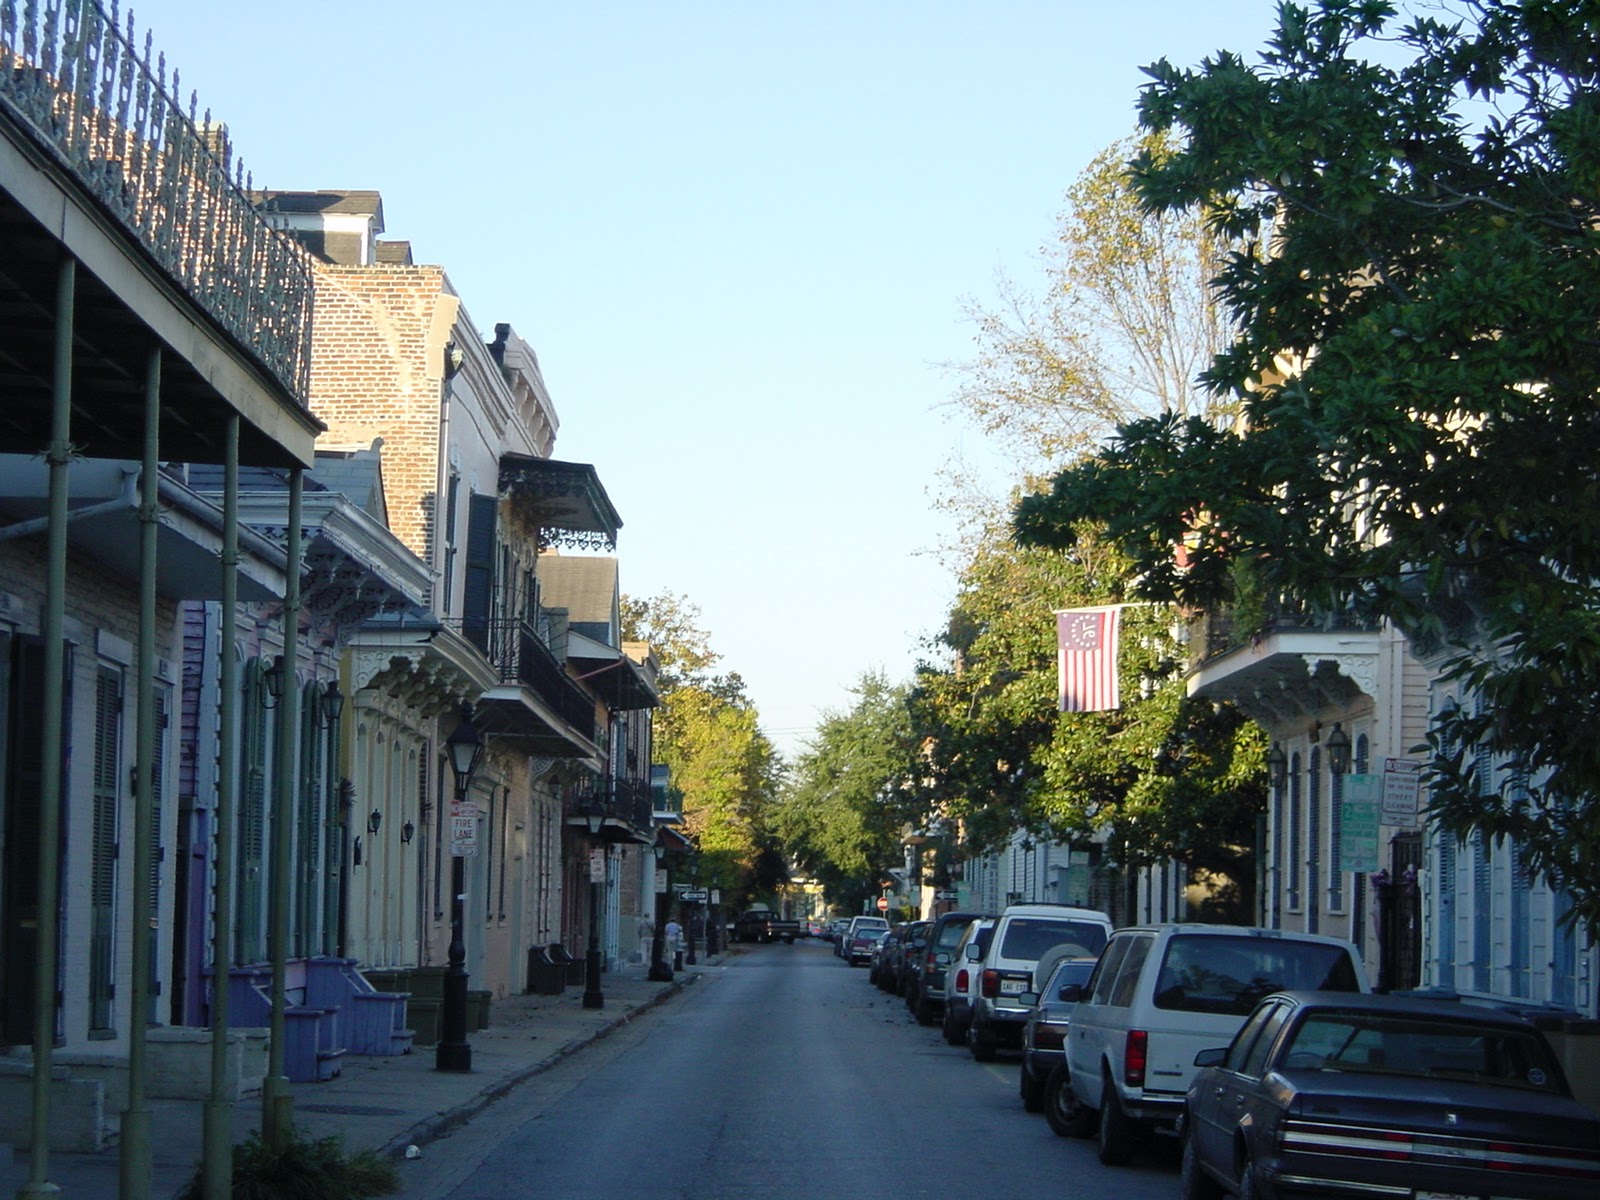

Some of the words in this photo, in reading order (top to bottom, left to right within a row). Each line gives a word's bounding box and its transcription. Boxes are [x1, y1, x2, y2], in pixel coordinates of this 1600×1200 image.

[1387, 793, 1413, 801] STREET
[1385, 802, 1415, 810] CLEANING
[455, 819, 473, 828] FIRE
[454, 829, 473, 838] LANE
